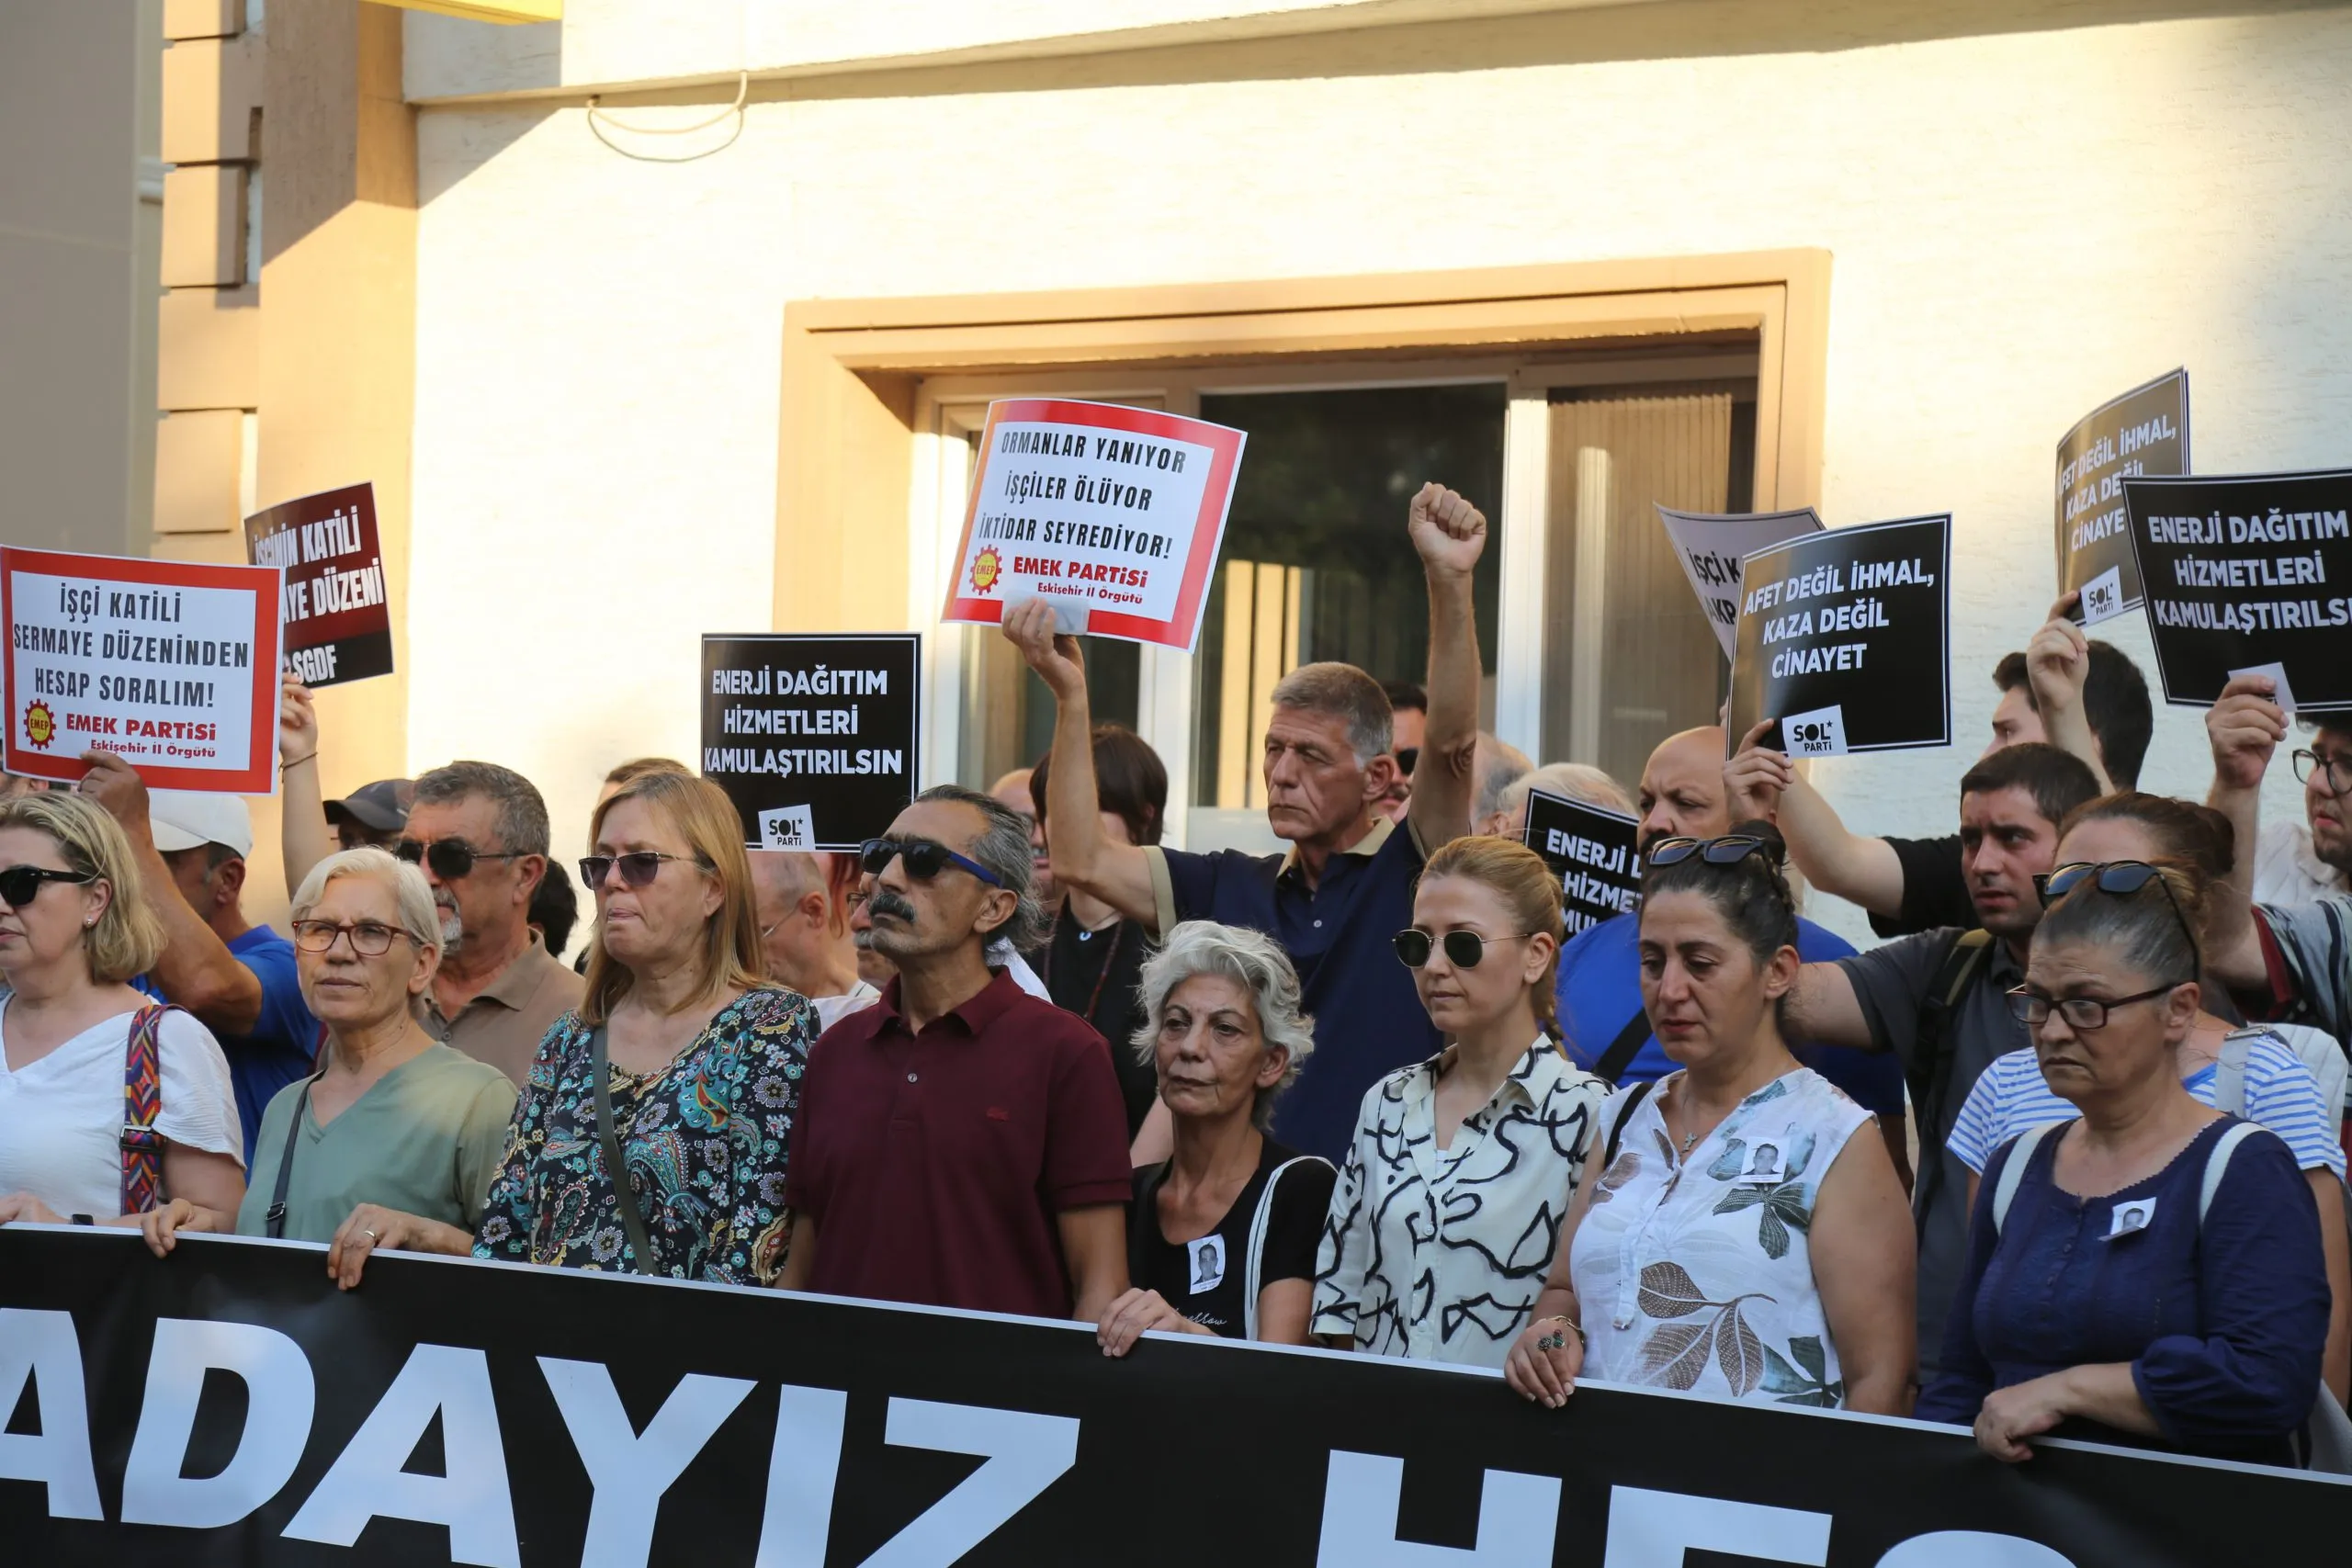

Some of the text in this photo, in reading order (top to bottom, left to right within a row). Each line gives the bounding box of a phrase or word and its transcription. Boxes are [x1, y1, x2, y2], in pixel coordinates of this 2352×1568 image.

[1001, 432, 1186, 473] ORMANLAR YANIYOR
[2078, 435, 2117, 479] DEĞİL
[2120, 414, 2177, 457] İHMAL,
[1005, 469, 1152, 511] İŞÇİLER ÖLÜYOR
[2066, 483, 2098, 523] KAZA
[301, 505, 362, 563] KATİLİ
[978, 513, 1172, 559] İKTİDAR SEYREDİYOR!
[2071, 507, 2126, 553] CİNAYE
[2148, 507, 2350, 545] ENERJİ DAĞITIM
[311, 557, 384, 617] DÜZENİ
[1013, 557, 1063, 578] EMEK
[1687, 547, 1728, 587] İŞÇİ
[1744, 558, 1934, 616] AFET DEĞİL İHMAL,
[2174, 549, 2326, 588] HİZMETLERİ
[61, 581, 181, 624] İŞÇİ KATİLİ
[1037, 582, 1083, 597] Eskişehir
[1099, 585, 1143, 604] Örgütü
[1763, 598, 1889, 645] KAZA DEĞİL
[14, 623, 248, 668] SERMAYE DÜZENİNDEN
[292, 644, 337, 684] SGDF
[1771, 643, 1867, 679] CİNAYET
[35, 667, 214, 707] HESAP SORALIM!
[712, 664, 888, 695] ENERJİ DAĞITIM
[30, 718, 50, 730] EMEP
[66, 713, 118, 735] EMEK
[724, 704, 858, 735] HİZMETLERİ
[1793, 724, 1830, 742] SOL
[91, 739, 148, 754] Eskişehir
[166, 742, 216, 759] Örgütü
[705, 747, 902, 779] KAMULAŞTIRILSIN
[769, 818, 801, 837] SOL
[1546, 828, 1627, 874] ENERJİ
